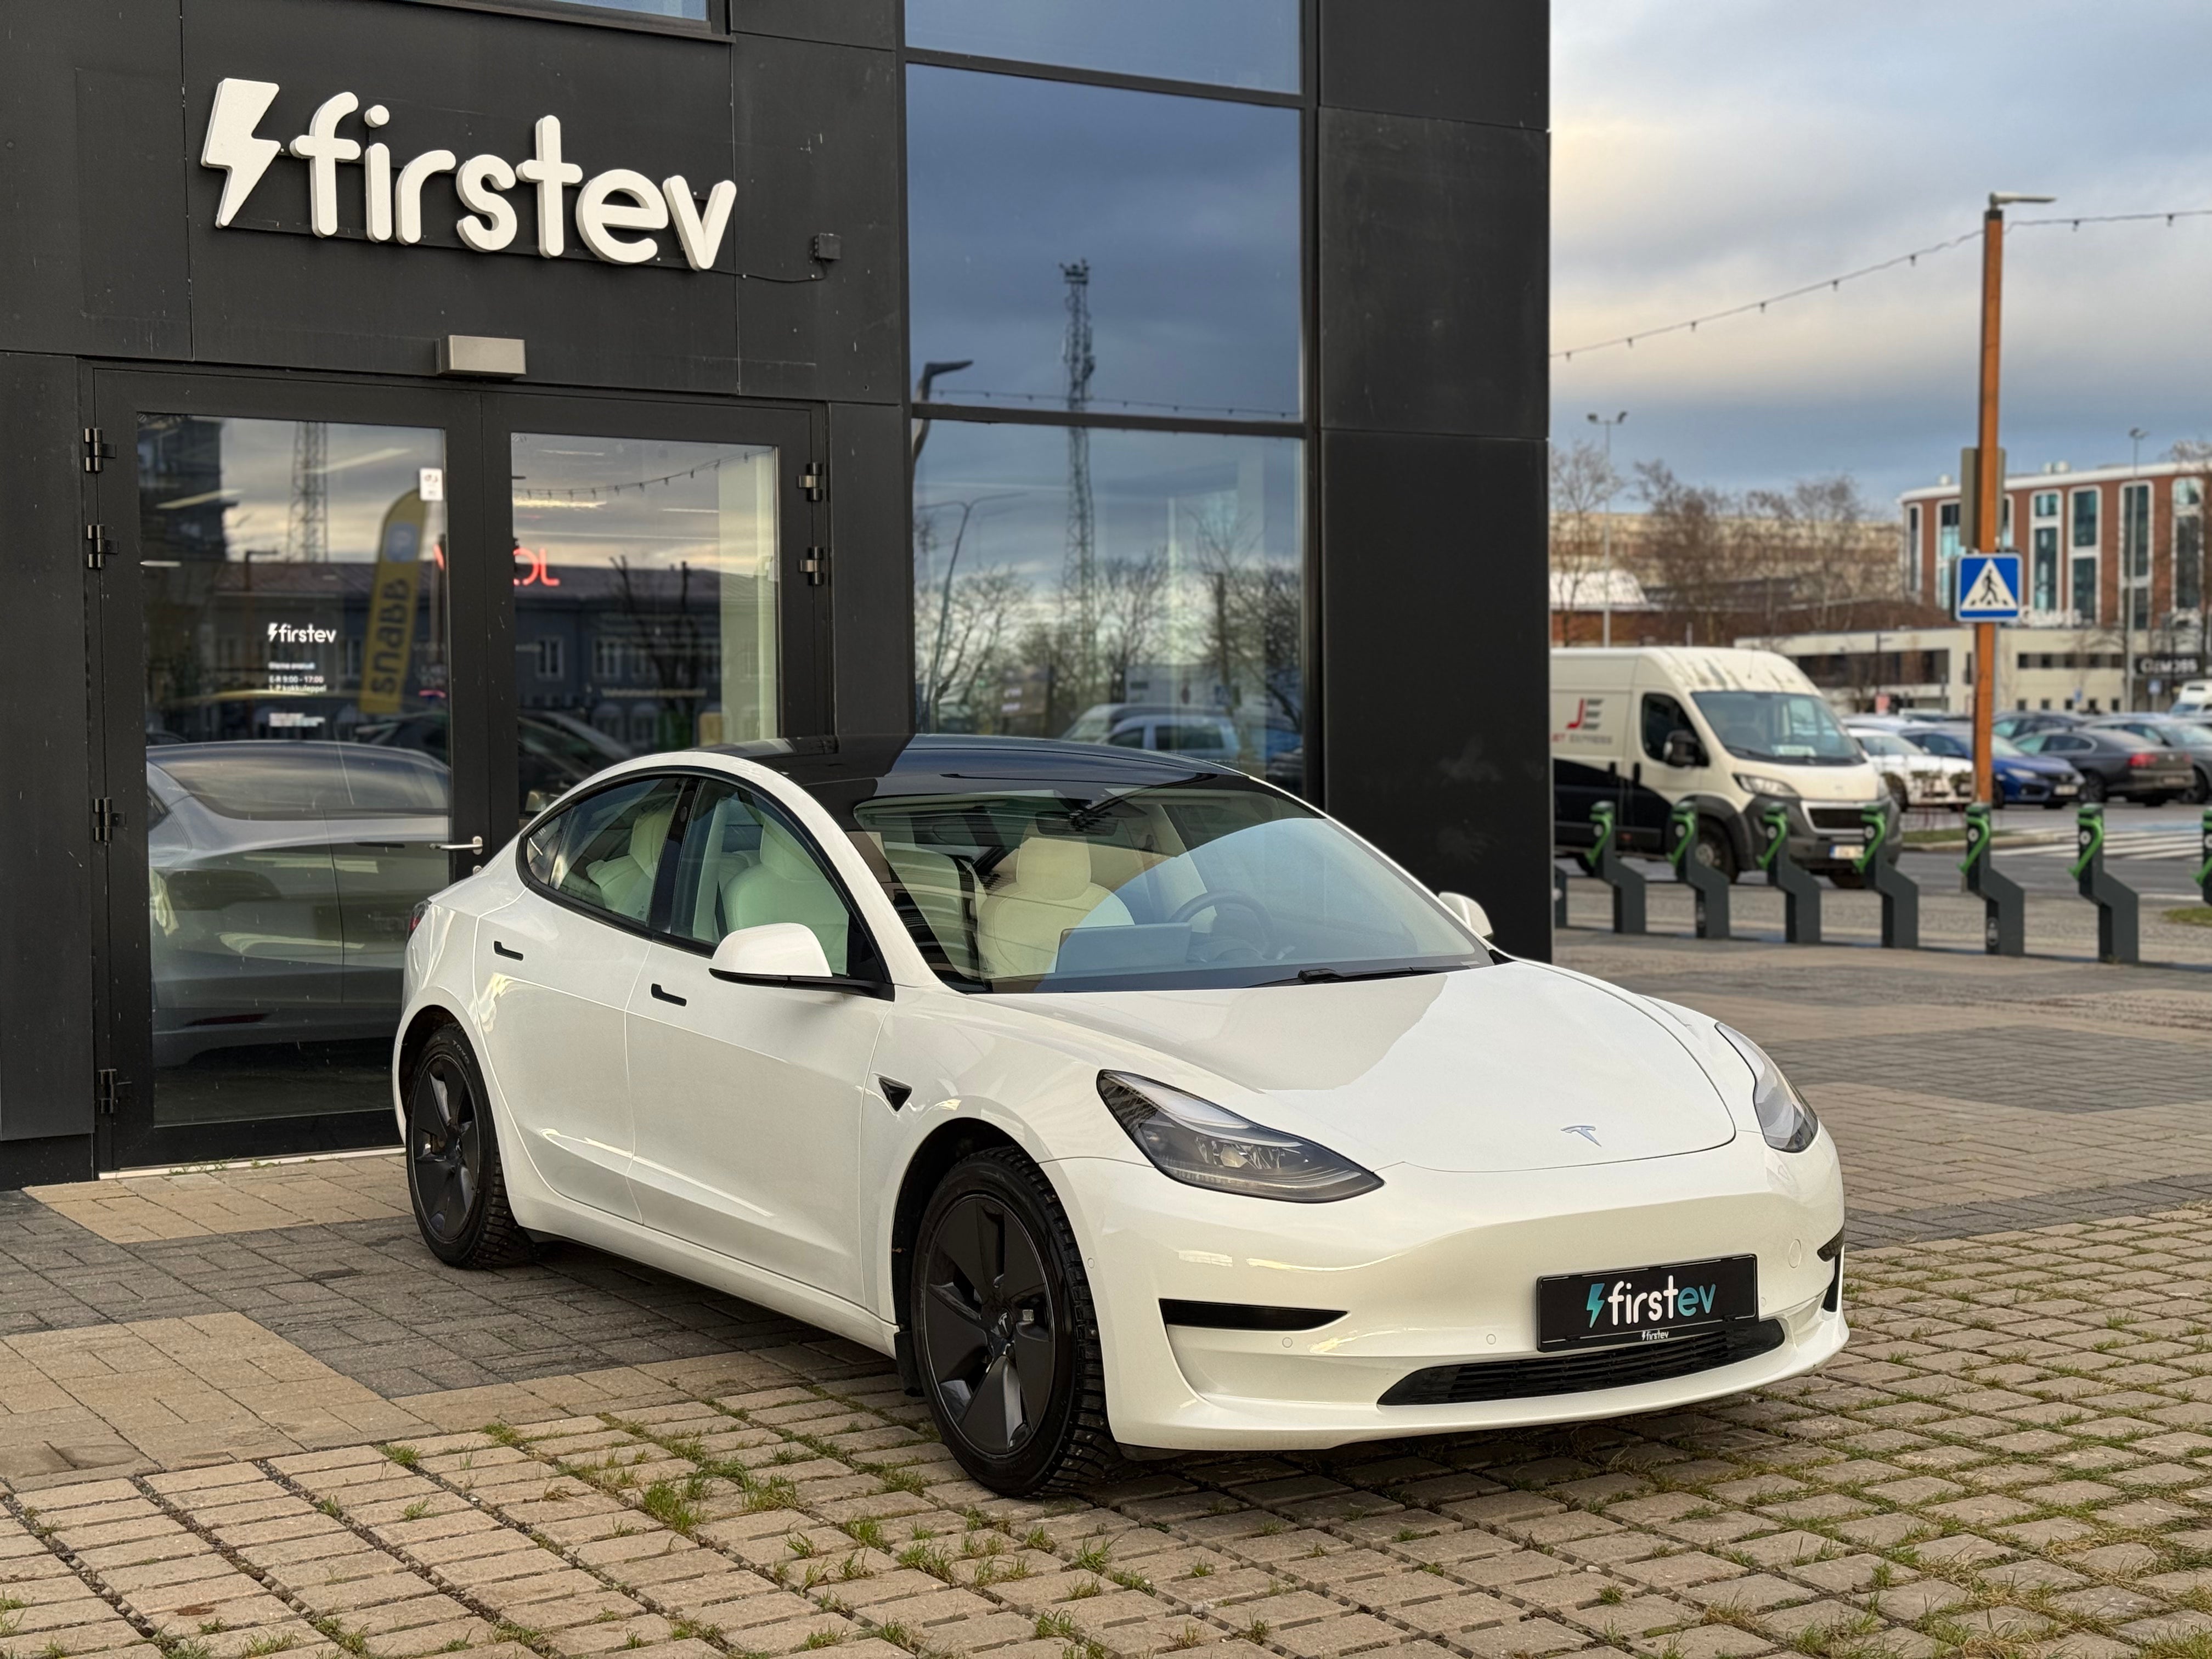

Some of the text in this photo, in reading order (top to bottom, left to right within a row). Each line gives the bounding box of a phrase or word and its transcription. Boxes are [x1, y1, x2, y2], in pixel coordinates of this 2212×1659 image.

[290, 92, 737, 271] firstev
[279, 623, 337, 643] firstev
[283, 685, 326, 693] kokkuleppel
[1552, 733, 1565, 742] ET
[453, 1040, 470, 1064] TOYO
[1608, 1275, 1716, 1326] firstev
[1646, 1329, 1669, 1341] firstev
